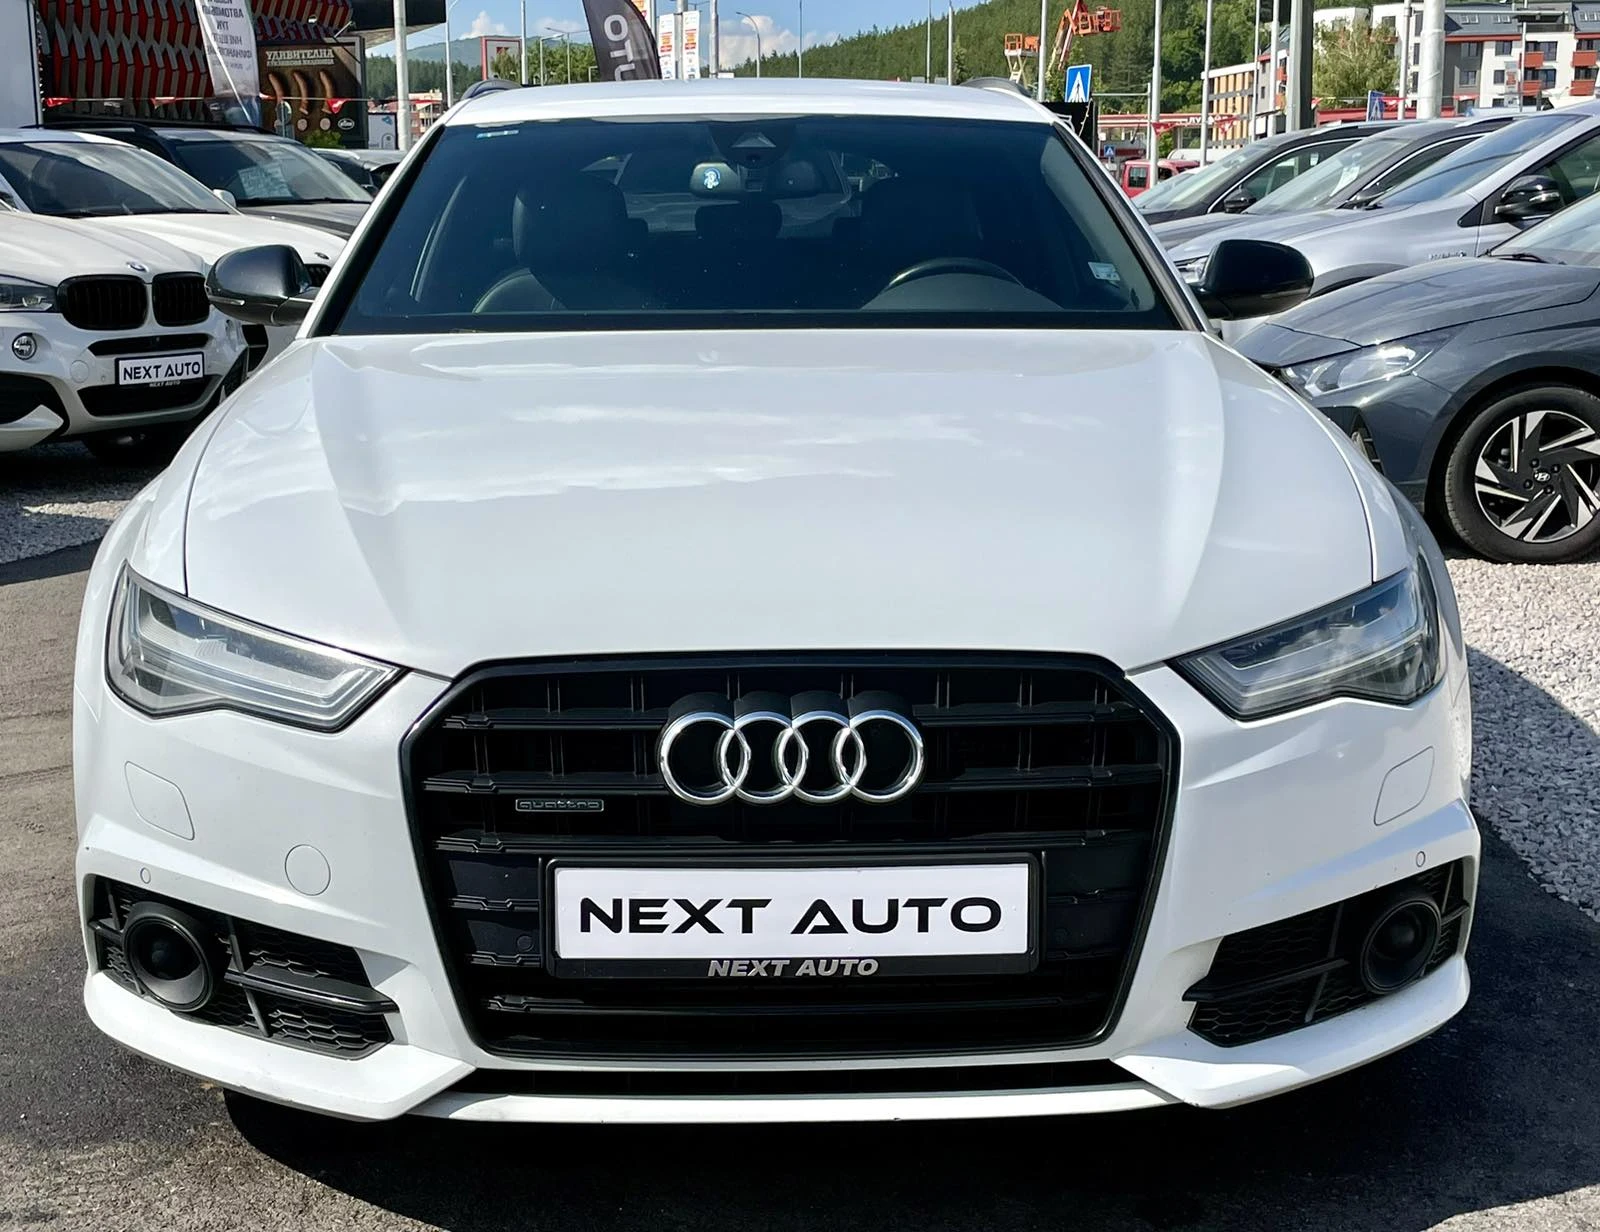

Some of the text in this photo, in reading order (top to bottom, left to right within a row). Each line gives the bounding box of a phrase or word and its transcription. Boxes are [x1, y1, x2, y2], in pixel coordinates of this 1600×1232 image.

[123, 361, 201, 380] NEXT AUTO
[520, 800, 600, 810] quattro
[580, 896, 1002, 935] NEXT AUTO
[707, 957, 879, 977] NEXT AUTO
